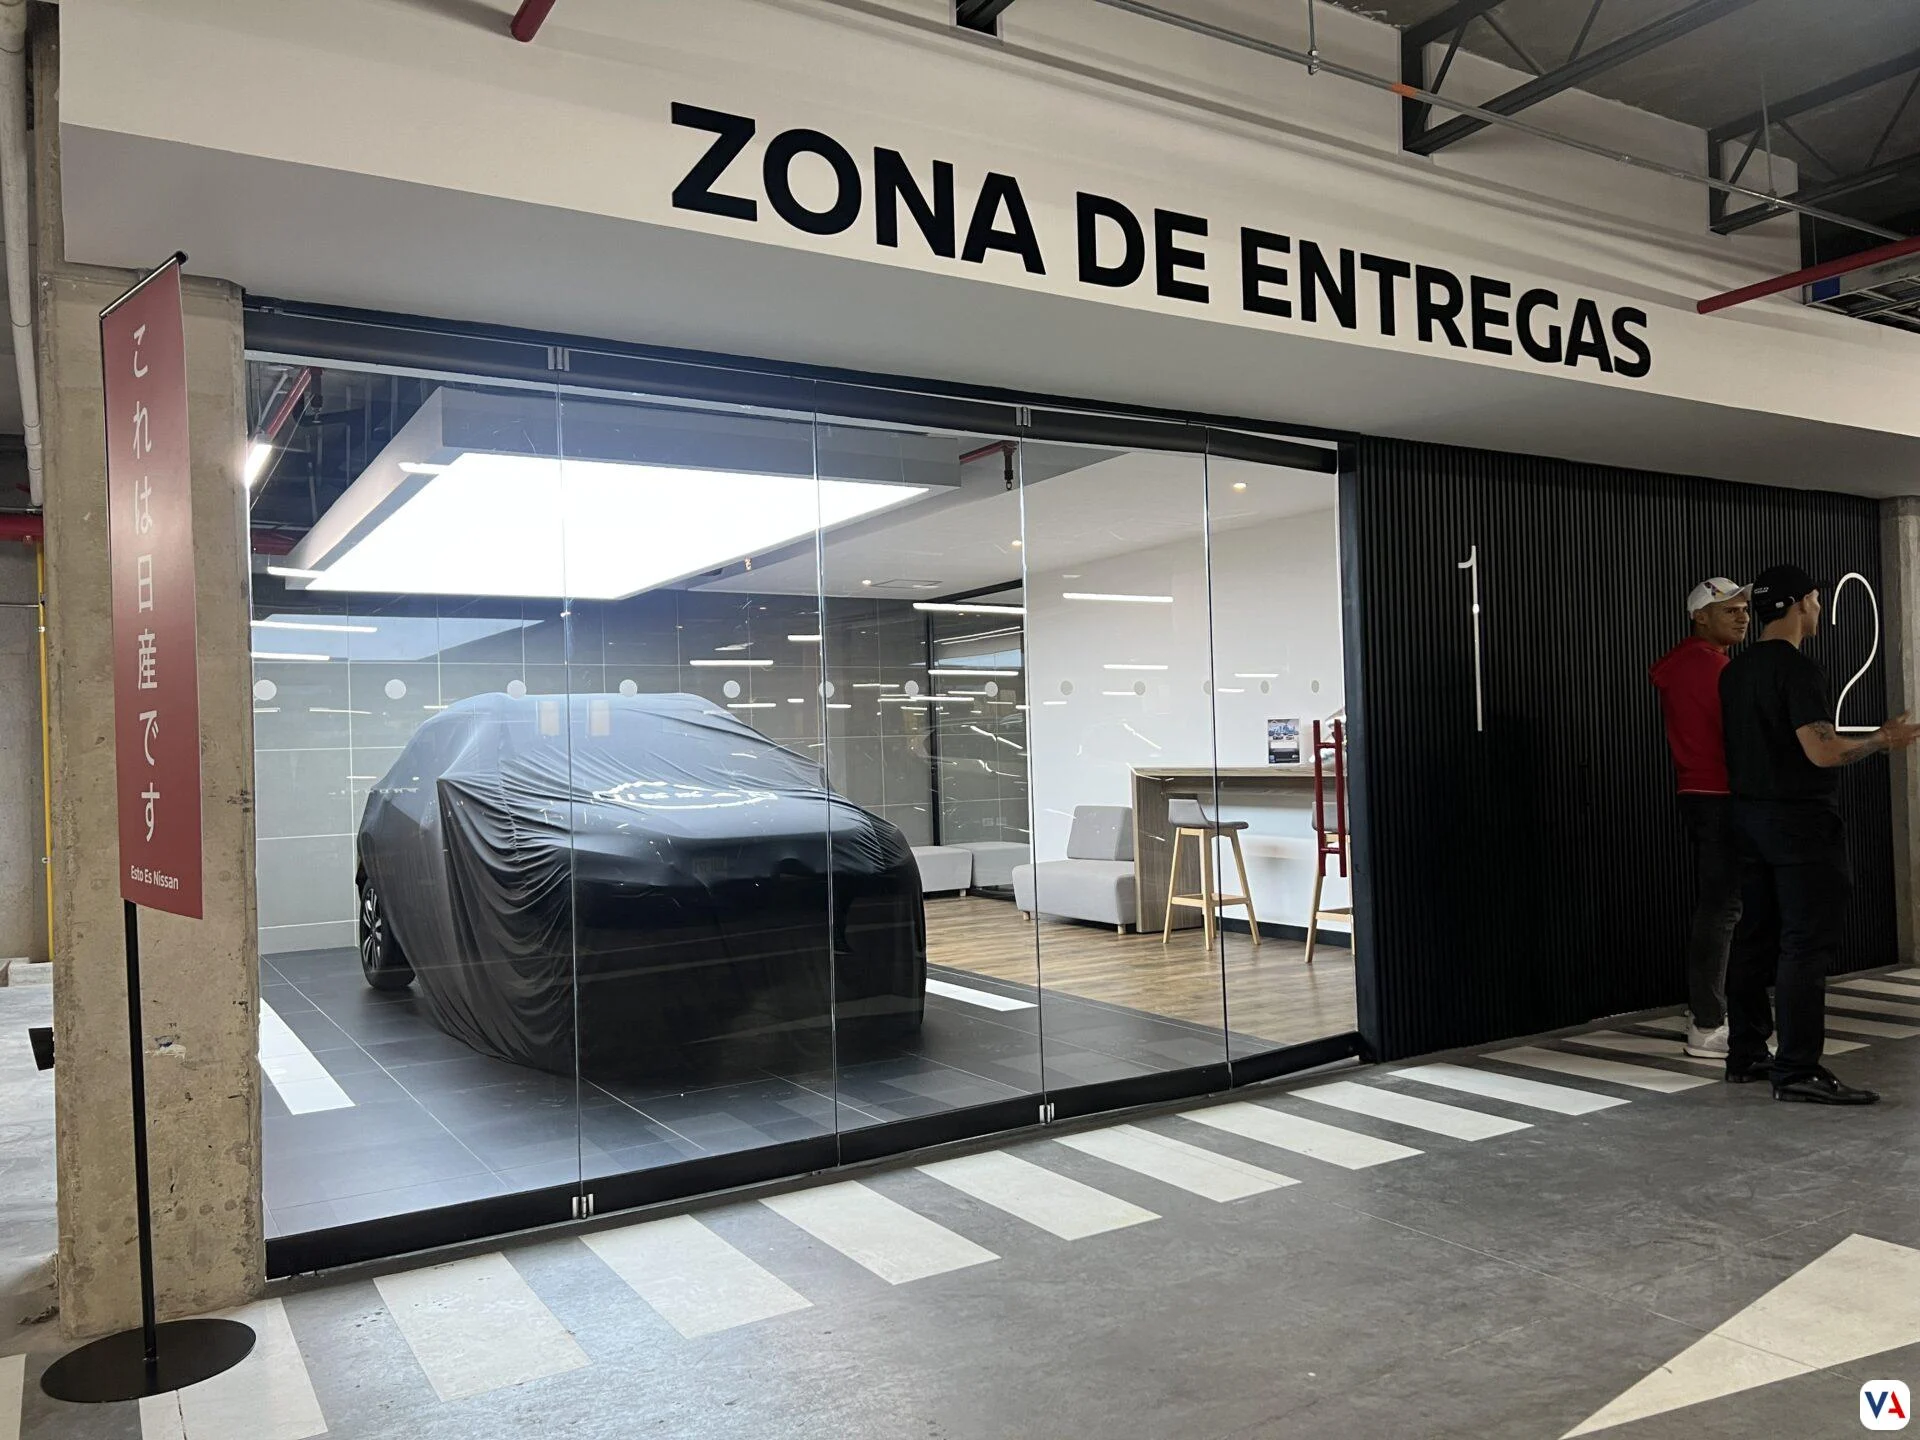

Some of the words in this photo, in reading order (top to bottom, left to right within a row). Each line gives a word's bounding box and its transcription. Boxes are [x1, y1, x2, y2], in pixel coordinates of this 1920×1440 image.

[671, 101, 1046, 275] ZONA
[1077, 191, 1210, 304] DE
[1241, 226, 1652, 378] ENTREGAS
[132, 323, 161, 843] これは日産です
[1457, 545, 1483, 732] 1
[1832, 572, 1881, 732] 2
[130, 865, 144, 882] Esto
[144, 868, 152, 884] Es
[153, 870, 179, 890] Nissan
